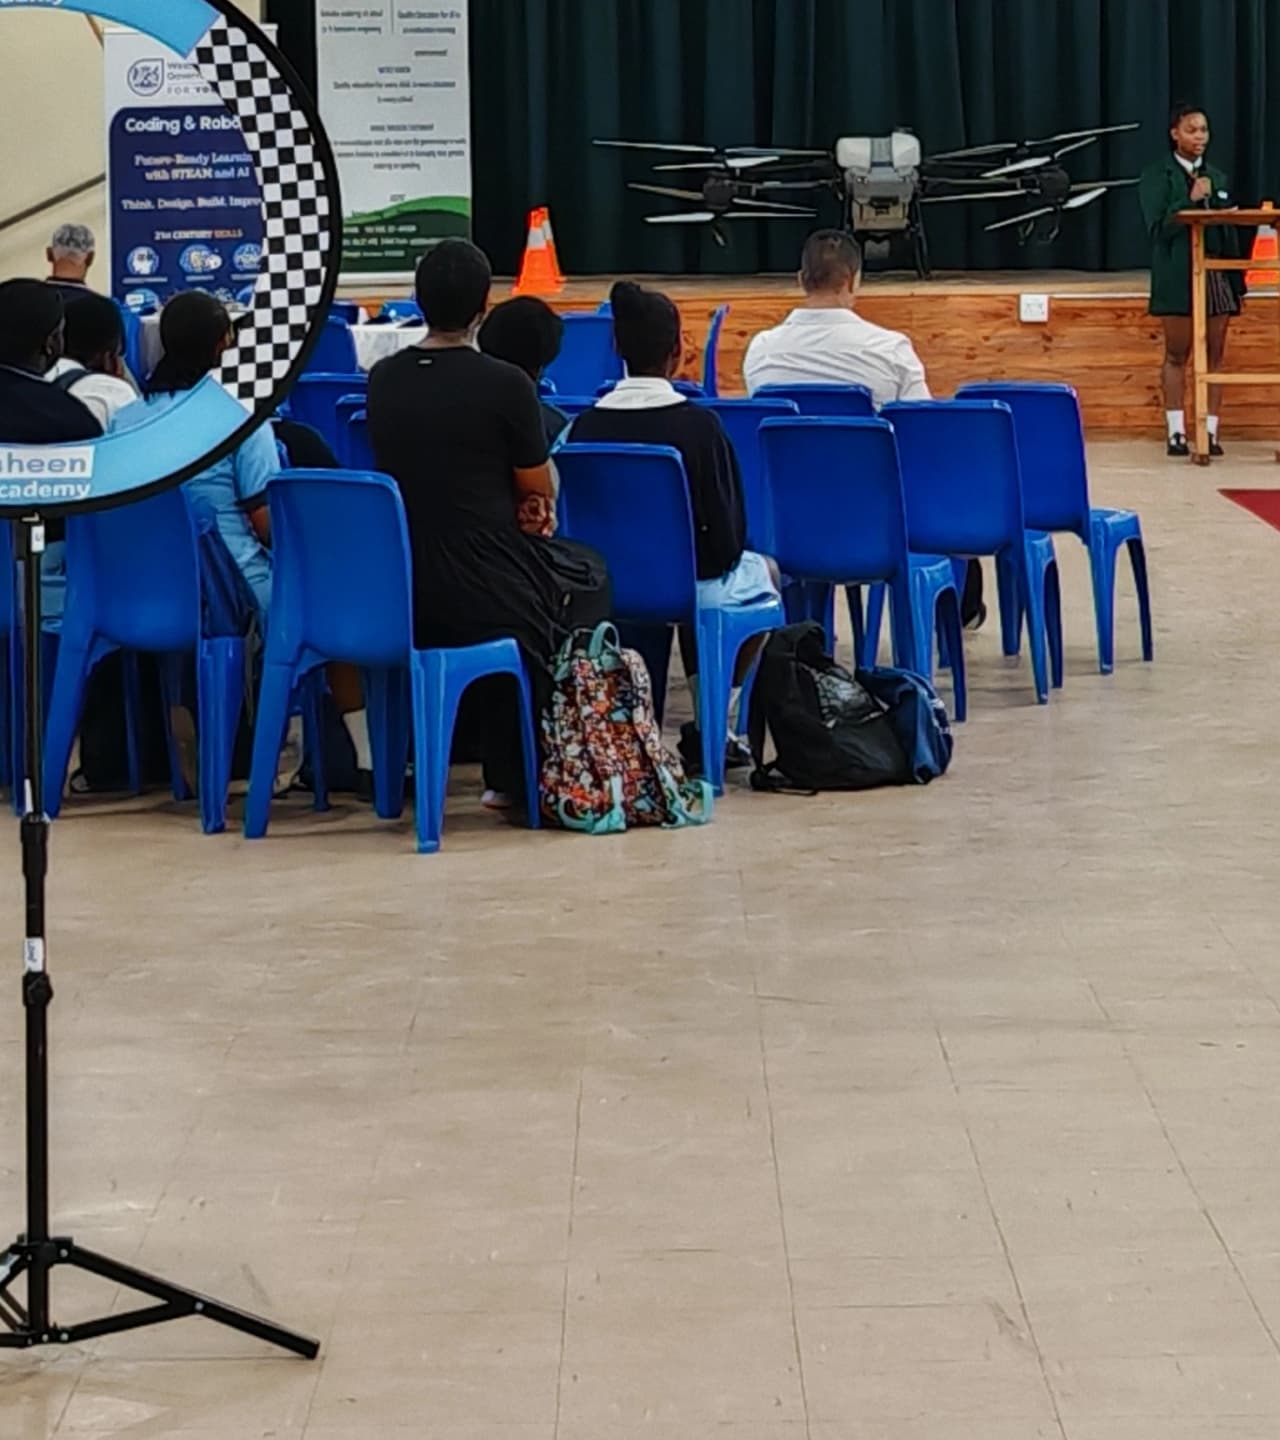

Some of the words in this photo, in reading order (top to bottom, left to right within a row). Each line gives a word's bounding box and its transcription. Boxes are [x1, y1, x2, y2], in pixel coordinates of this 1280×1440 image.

[125, 116, 180, 135] Coding
[183, 114, 196, 130] &
[134, 153, 210, 166] Future-Ready
[145, 169, 170, 180] with
[171, 168, 213, 180] STEAM
[214, 167, 235, 178] and
[236, 167, 250, 178] AI
